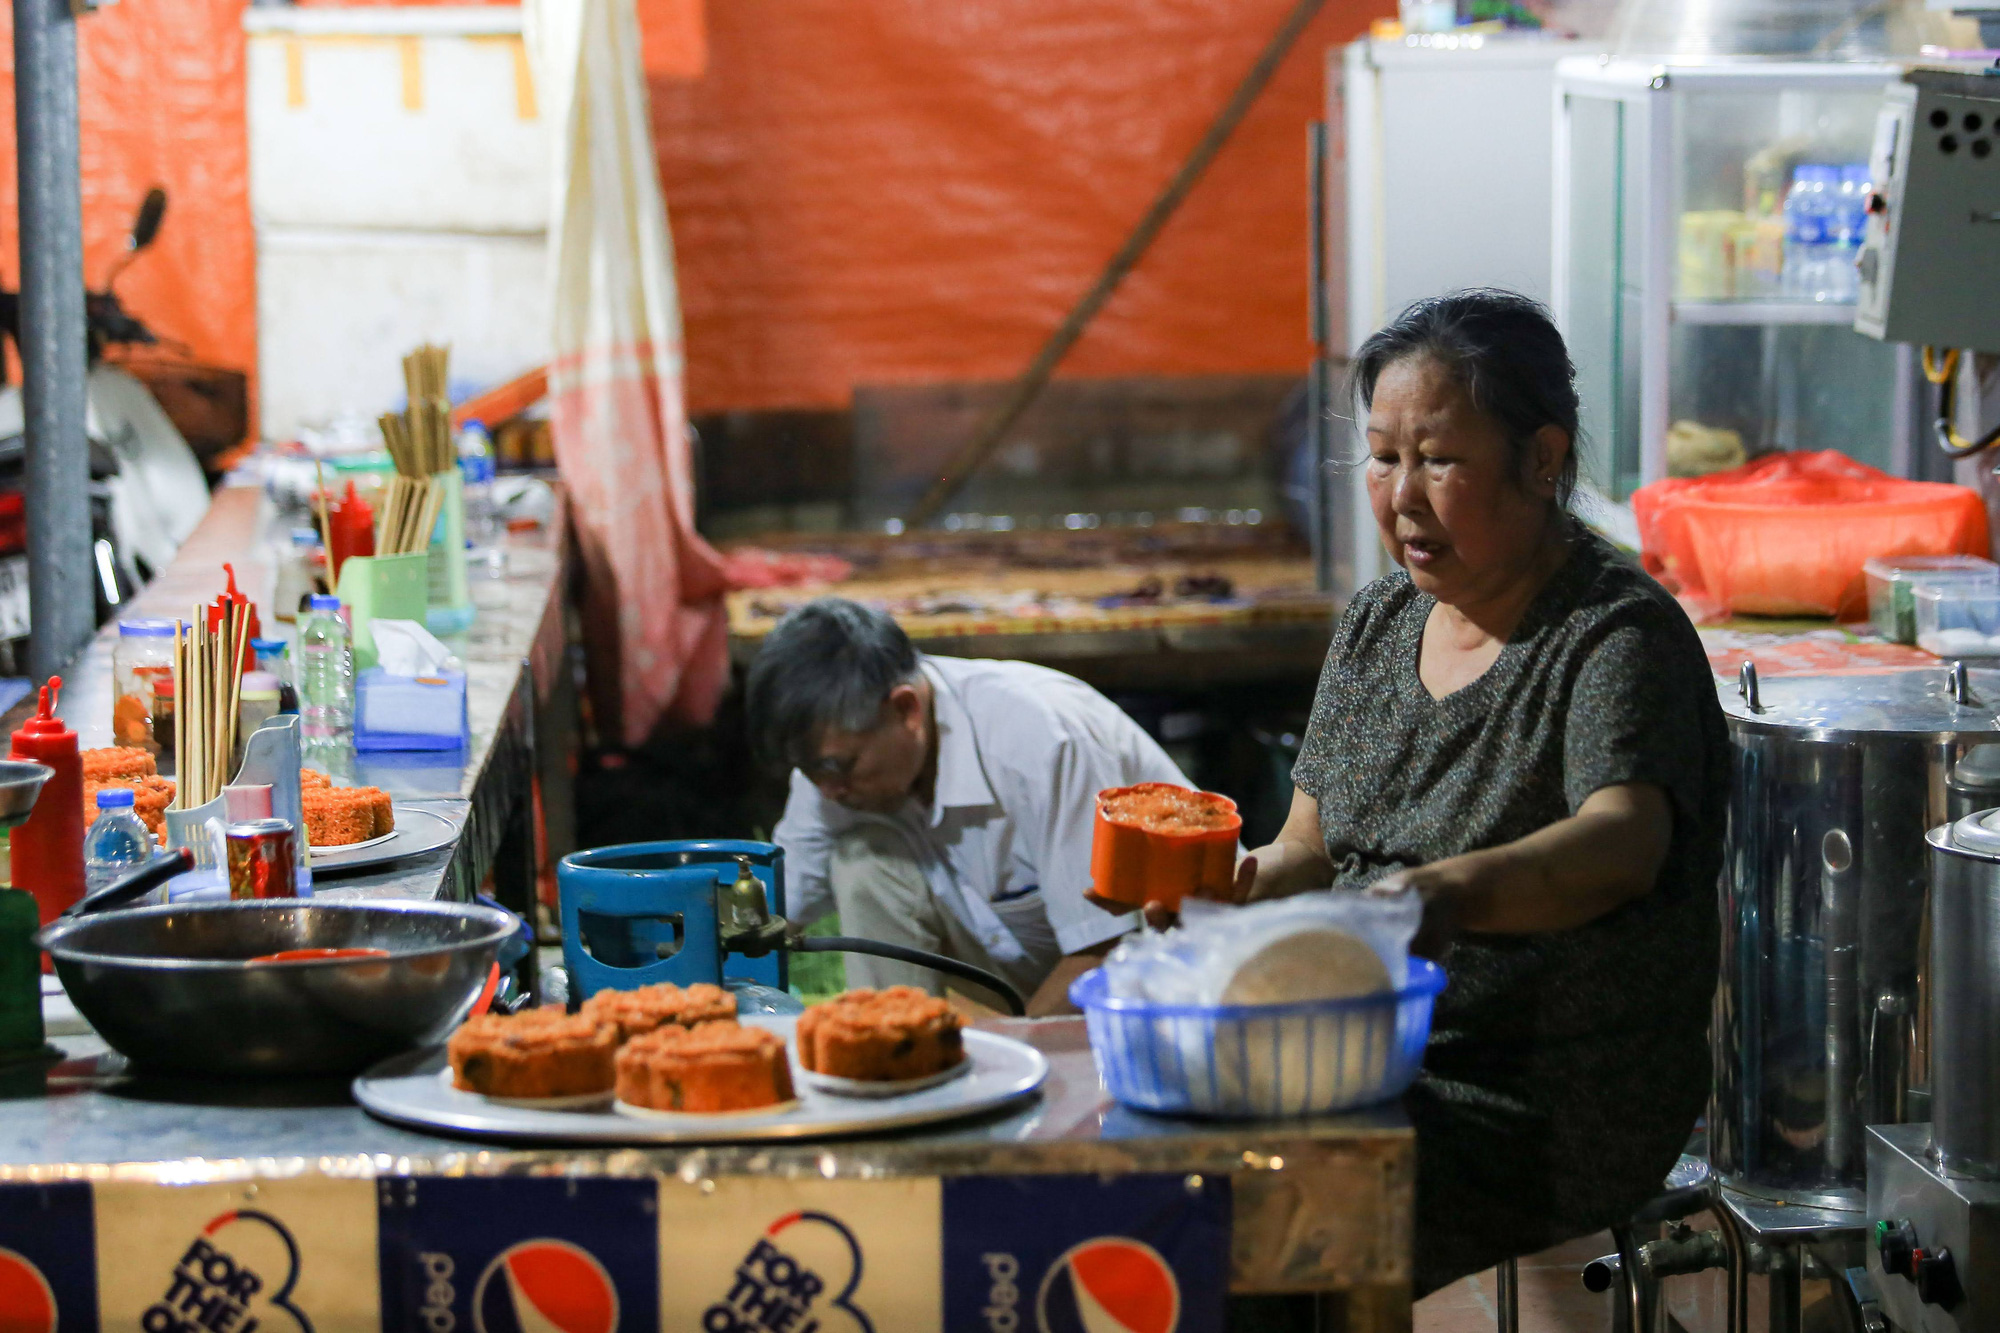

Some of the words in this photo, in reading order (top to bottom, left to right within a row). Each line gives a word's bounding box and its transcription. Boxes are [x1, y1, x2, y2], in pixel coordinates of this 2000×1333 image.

[163, 1265, 243, 1333] THE
[180, 1237, 263, 1306] FOR
[726, 1268, 806, 1333] THE
[743, 1238, 824, 1307] FOR
